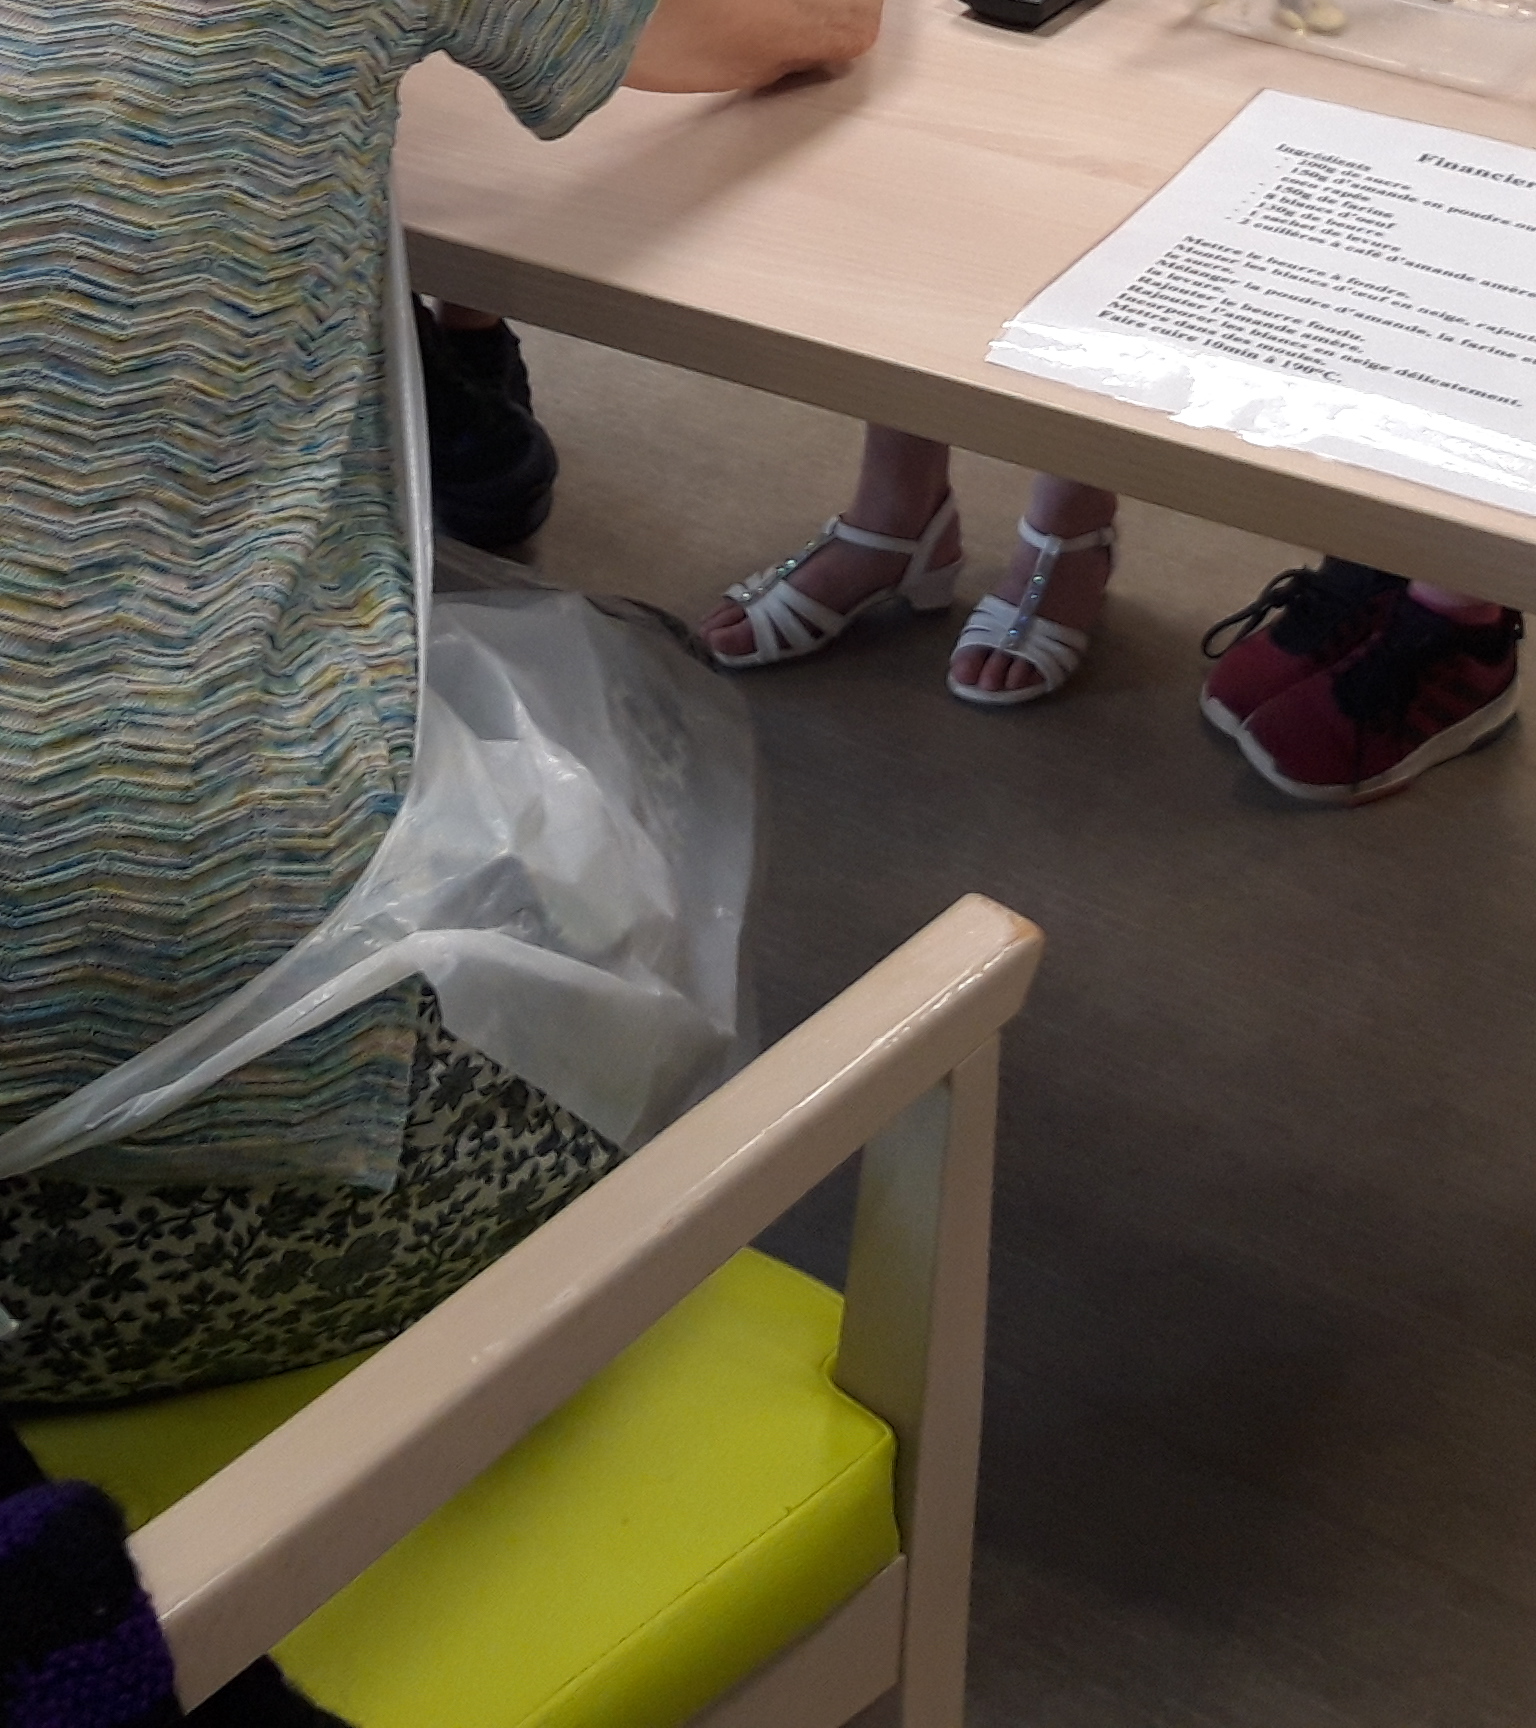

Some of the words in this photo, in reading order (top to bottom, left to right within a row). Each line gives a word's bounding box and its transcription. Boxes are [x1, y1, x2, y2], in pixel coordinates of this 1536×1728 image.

[1275, 143, 1372, 173] Ingrédients
[1280, 176, 1319, 189] coco
[1362, 176, 1412, 191] sucre
[1278, 195, 1335, 215] blancs
[1332, 178, 1419, 203] d'amande
[1446, 206, 1512, 226] poudre
[1340, 200, 1395, 219] farine
[1260, 214, 1317, 232] sachet
[1345, 232, 1402, 253] levure
[1325, 218, 1384, 238] beurre
[1173, 243, 1241, 265] Monter
[1270, 268, 1329, 288] blancs
[1181, 235, 1244, 256] Mettre
[1266, 256, 1327, 277] beurre
[1345, 277, 1411, 299] fondre.
[1183, 257, 1236, 275] sucre.
[1385, 255, 1476, 283] d'amande
[1126, 284, 1208, 310] Rajouter
[1166, 272, 1227, 294] levure.
[1135, 275, 1218, 301] Rajouter
[1239, 302, 1303, 325] beurre
[1306, 320, 1366, 343] fondu.
[1154, 259, 1241, 285] Mélanger
[1262, 288, 1332, 310] poudre
[1459, 338, 1519, 359] farine
[1097, 309, 1148, 329] Faire
[1148, 325, 1200, 343] cuire
[1106, 301, 1171, 323] Mettre
[1172, 320, 1218, 336] dans
[1255, 342, 1327, 366] moules.
[1116, 292, 1218, 324] Incorporer
[1248, 328, 1310, 350] blancs
[1339, 354, 1392, 372] neige
[1393, 368, 1523, 408] délicatement.
